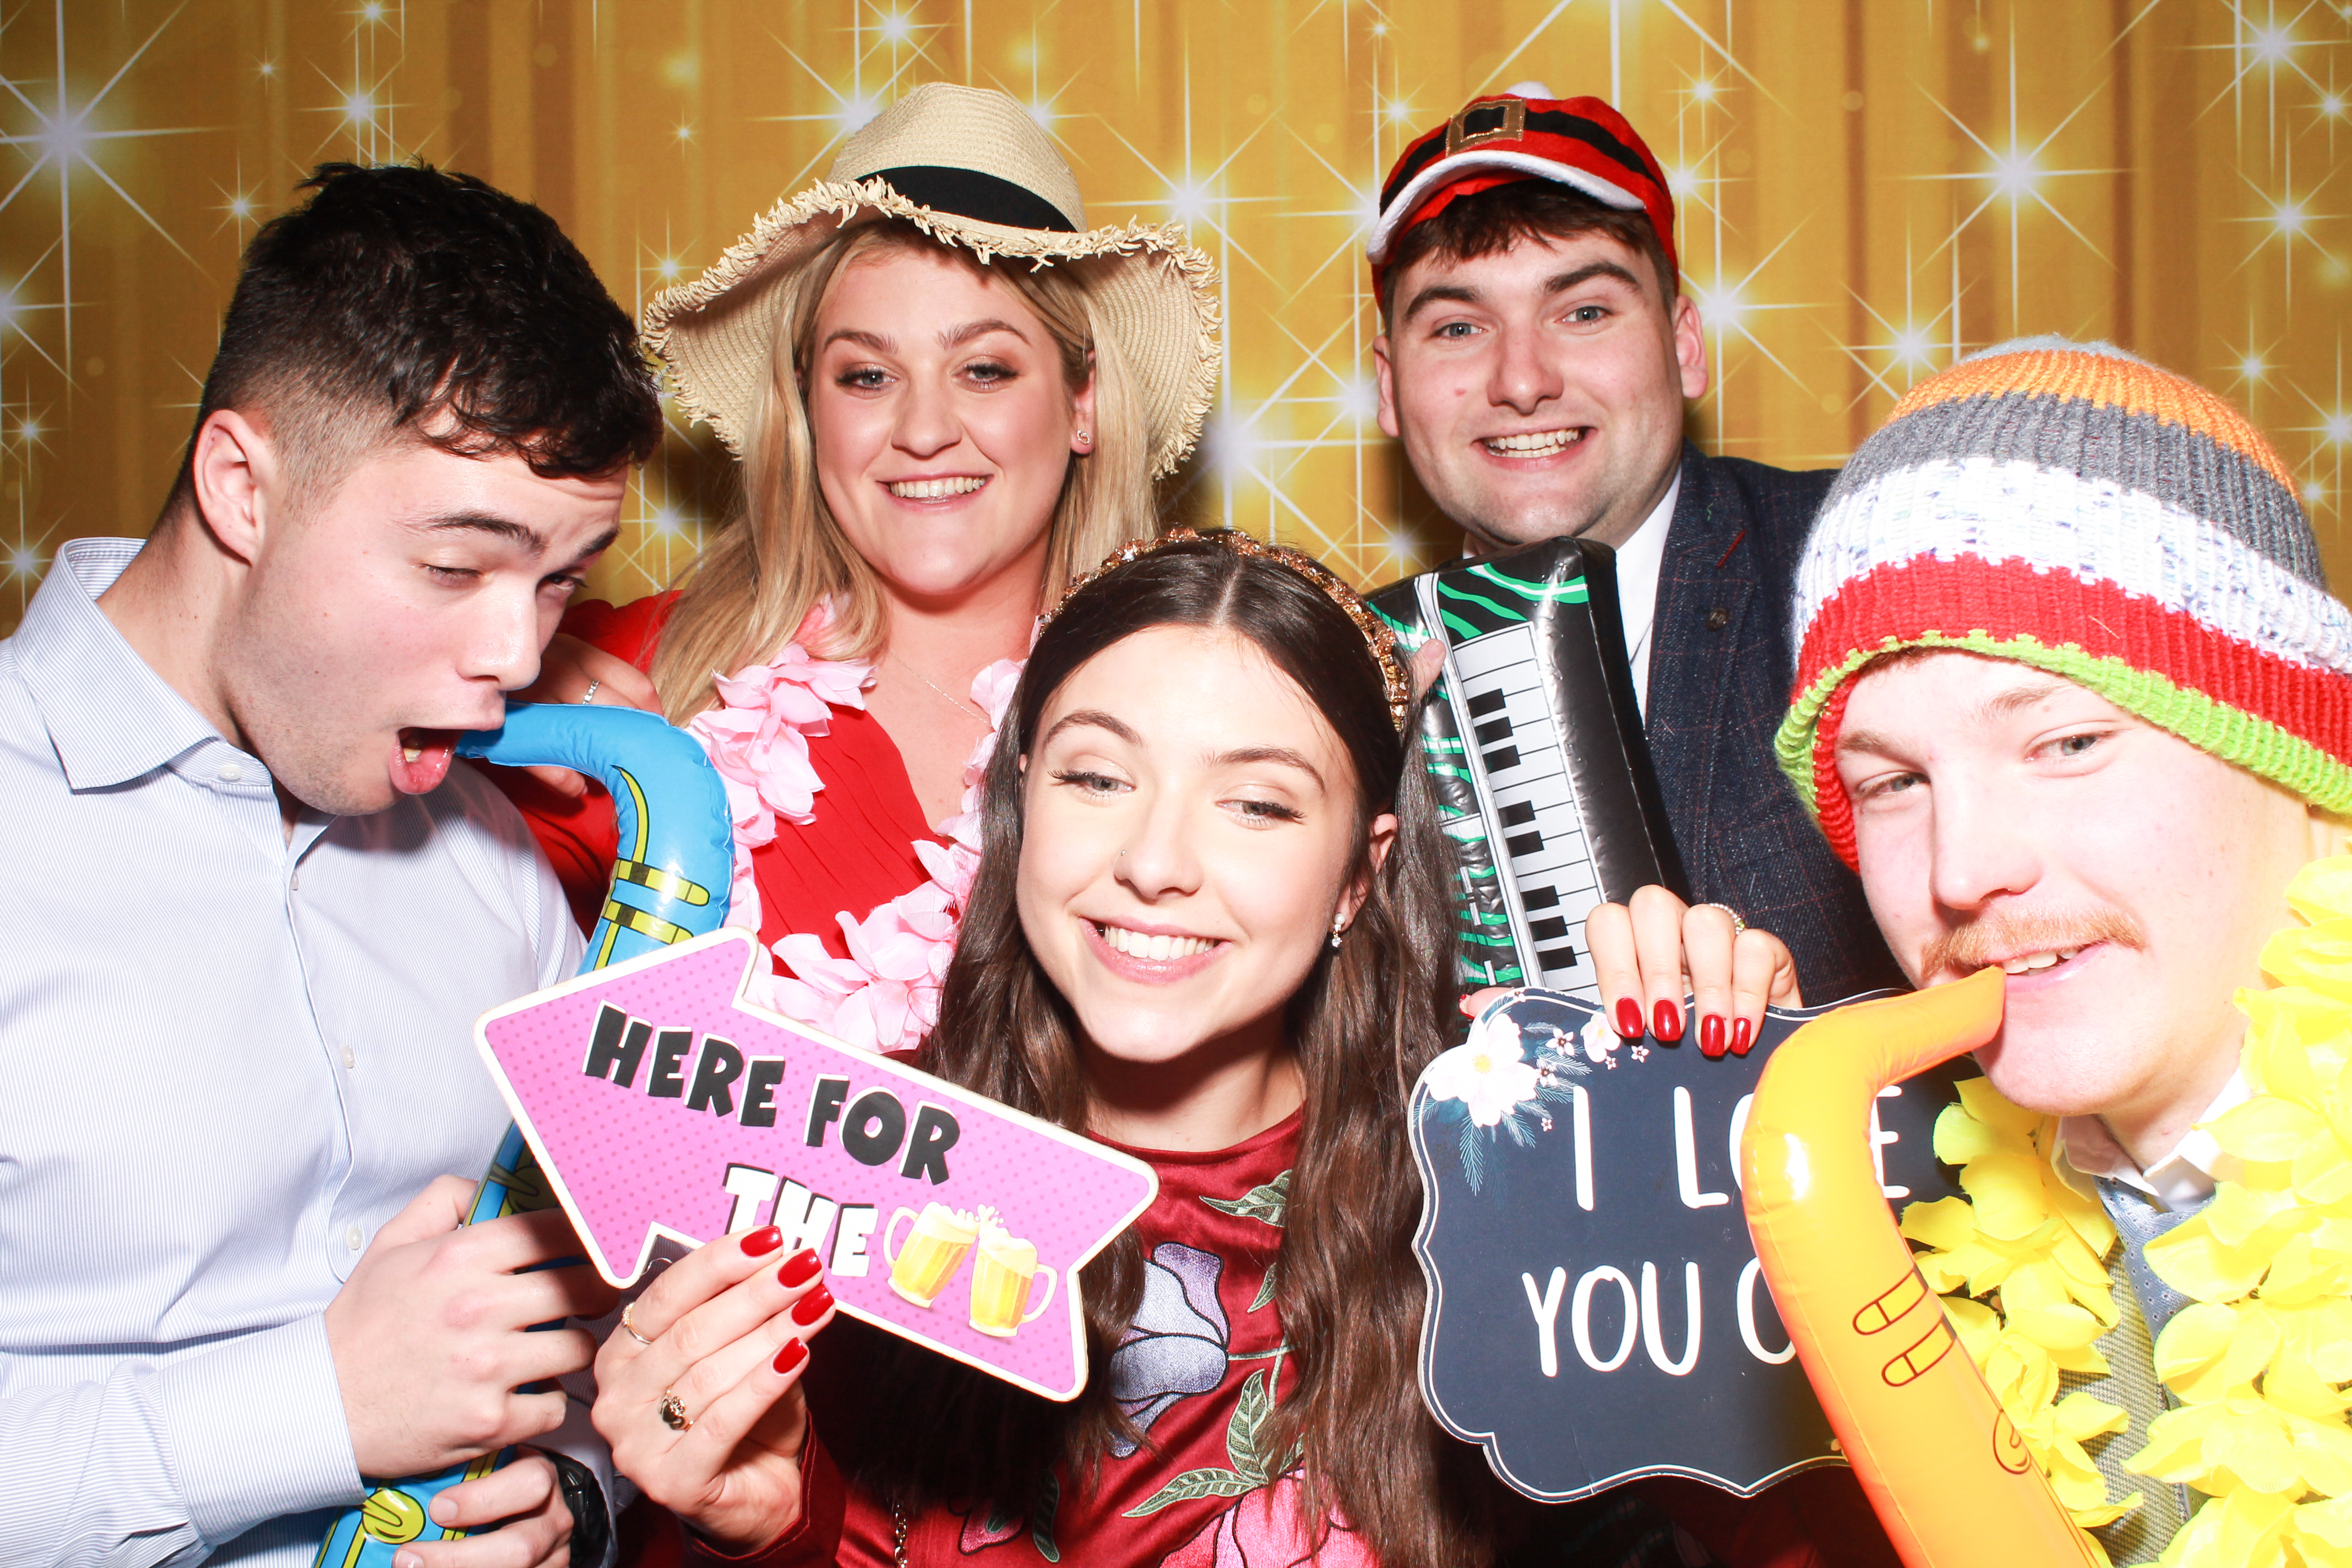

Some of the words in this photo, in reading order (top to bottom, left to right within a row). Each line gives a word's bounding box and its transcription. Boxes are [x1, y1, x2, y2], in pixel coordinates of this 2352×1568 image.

[582, 998, 786, 1128] HERE
[805, 1075, 961, 1185] FOR
[1572, 1085, 1594, 1211] I
[1673, 1085, 1911, 1209] LE
[724, 1163, 879, 1278] THE
[1521, 1260, 1702, 1378] YOU
